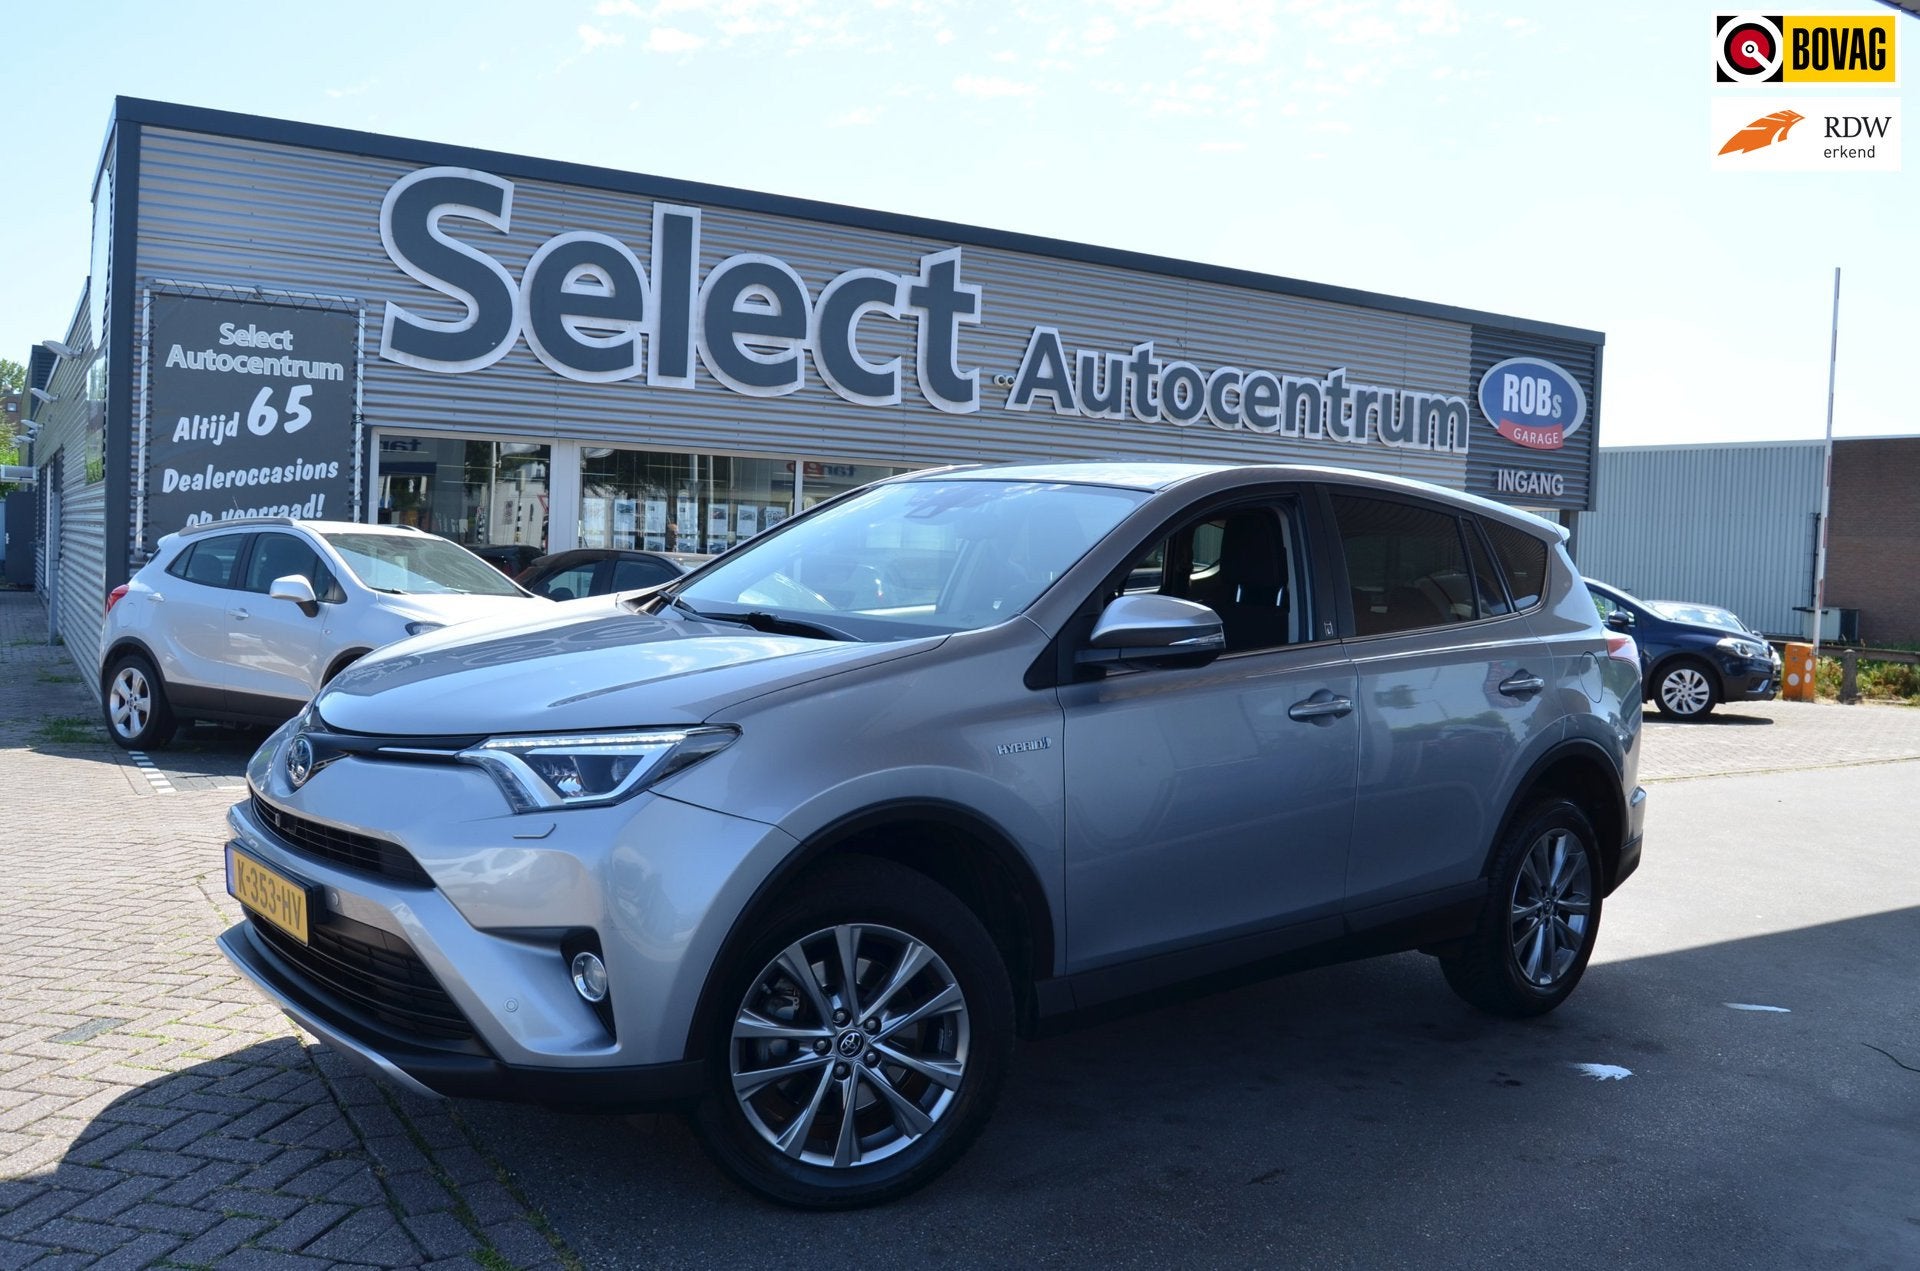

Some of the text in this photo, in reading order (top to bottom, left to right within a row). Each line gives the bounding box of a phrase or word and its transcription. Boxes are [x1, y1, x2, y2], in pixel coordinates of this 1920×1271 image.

[379, 166, 1469, 454] Select Autocentrum
[219, 322, 293, 351] Select
[165, 344, 344, 381] Autocentrum
[172, 384, 313, 446] Altijd 65
[1513, 427, 1559, 445] GARAGE
[162, 458, 338, 493] Dealeroccasions
[1497, 468, 1564, 496] INGANG
[996, 736, 1052, 755] HYBRID
[237, 858, 302, 930] K-353-HV
